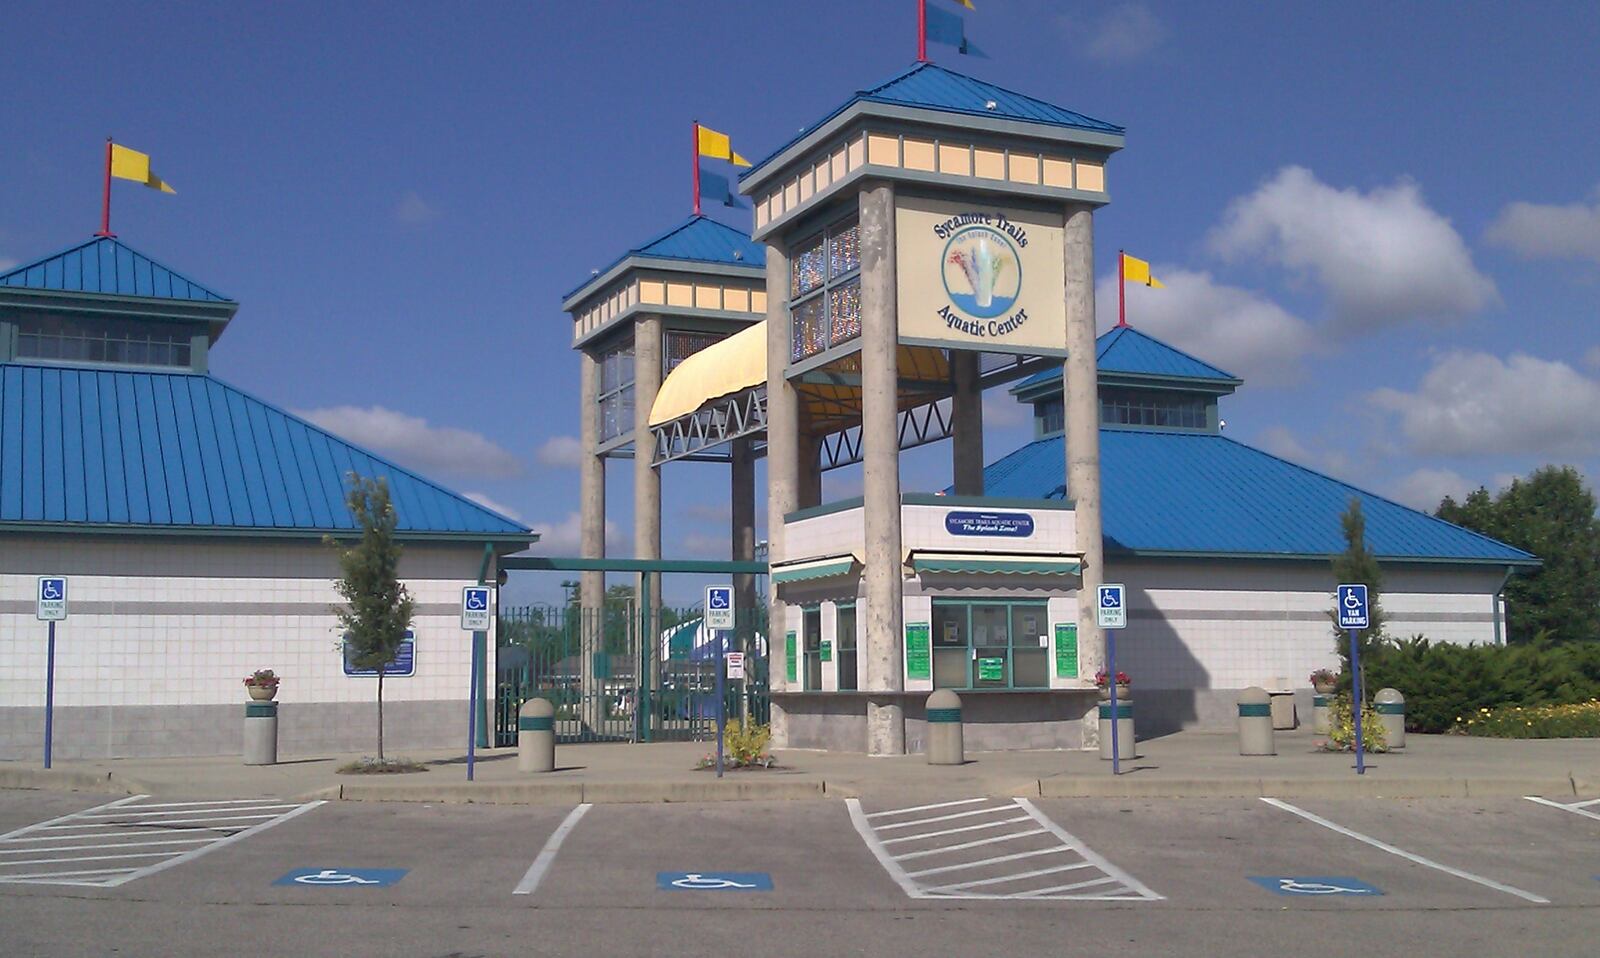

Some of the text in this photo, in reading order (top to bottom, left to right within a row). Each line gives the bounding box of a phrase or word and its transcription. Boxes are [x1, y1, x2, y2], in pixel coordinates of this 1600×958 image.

[934, 212, 1029, 248] Sycamore Trails
[937, 305, 1028, 337] Aquatic Center
[976, 524, 998, 532] Splash
[464, 611, 488, 619] PARKING
[1100, 609, 1122, 617] PARKING
[1347, 609, 1360, 617] VAN
[1342, 616, 1366, 625] PARKING
